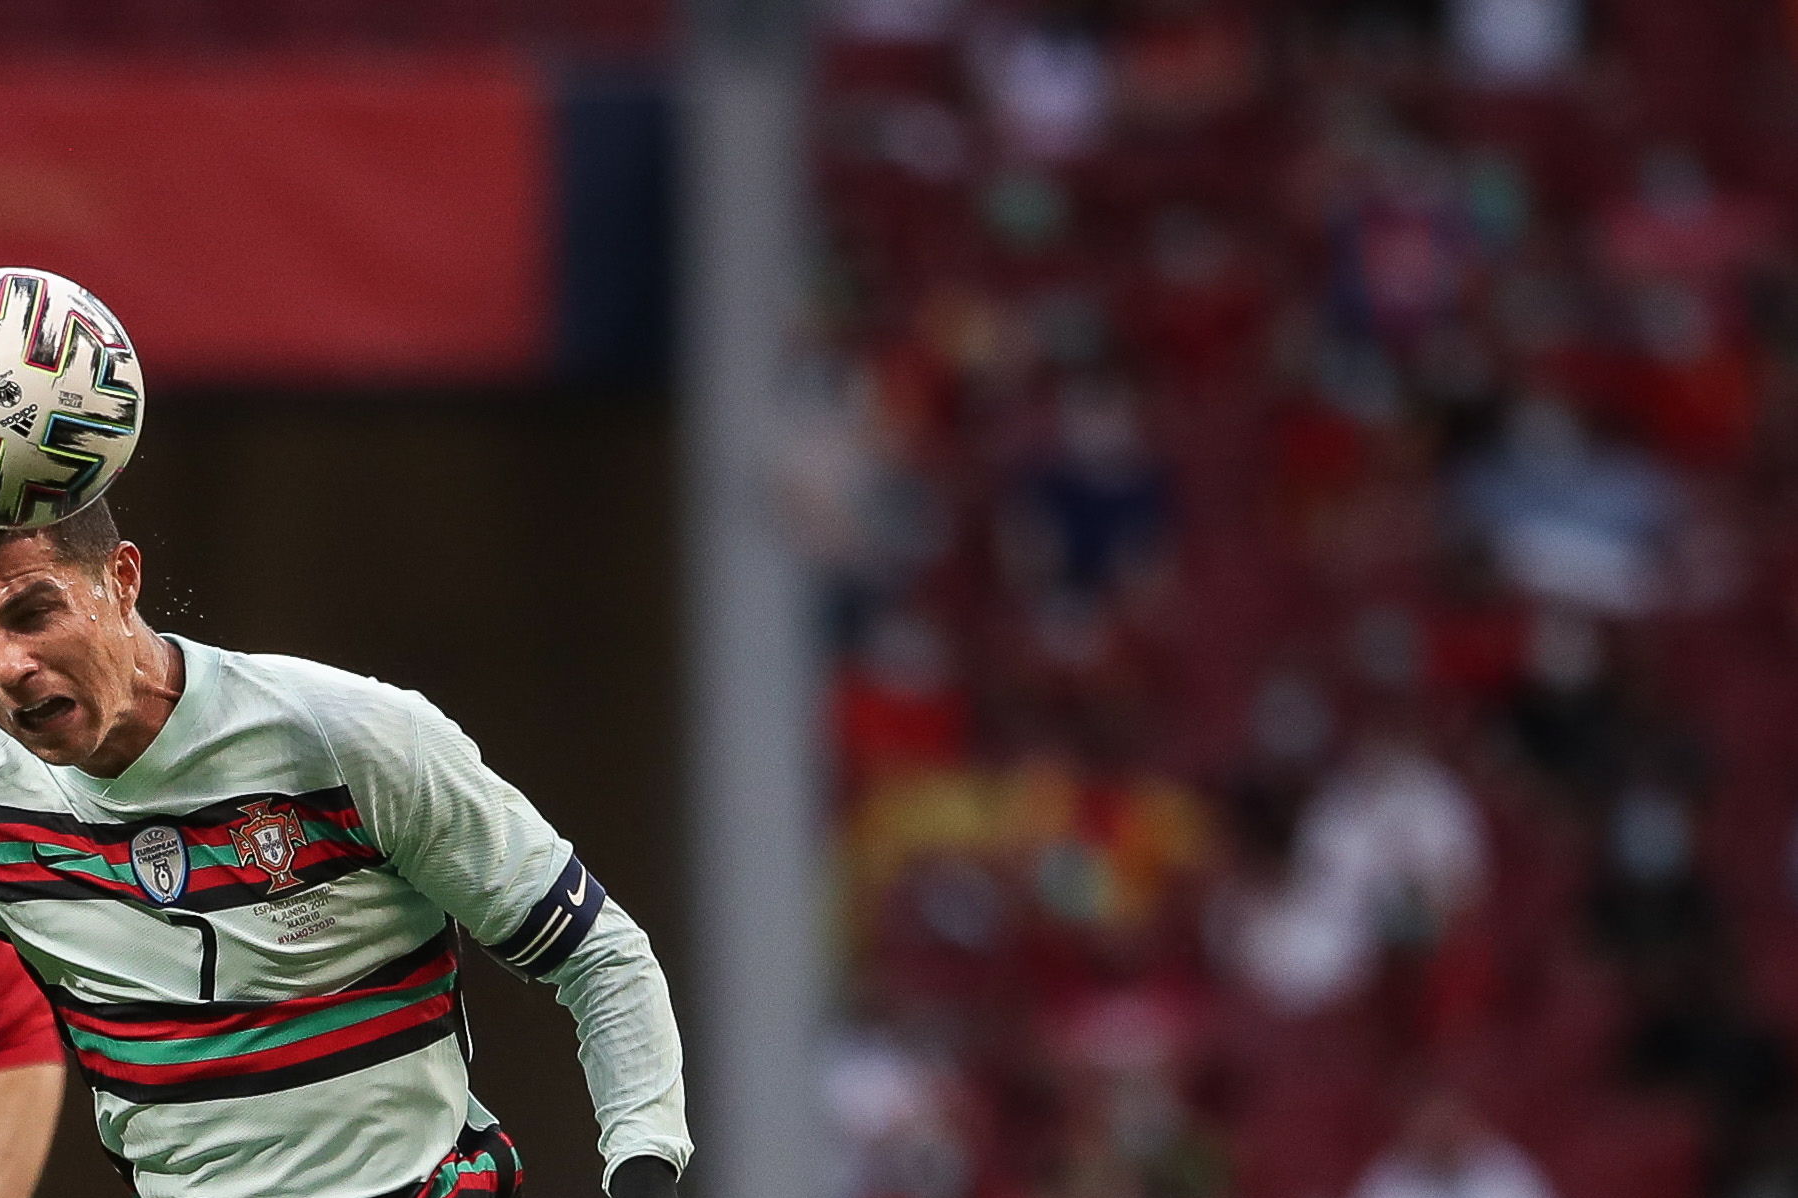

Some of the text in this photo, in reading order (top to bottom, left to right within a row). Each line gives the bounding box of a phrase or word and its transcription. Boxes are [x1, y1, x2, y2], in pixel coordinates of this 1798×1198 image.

[0, 403, 38, 428] adidas
[135, 839, 178, 856] EUROPEAN
[281, 905, 307, 920] JUNHO
[310, 896, 330, 911] 2021
[287, 911, 321, 929] MADRID
[277, 917, 336, 945] #VAMOS2030
[168, 913, 216, 1001] 7
